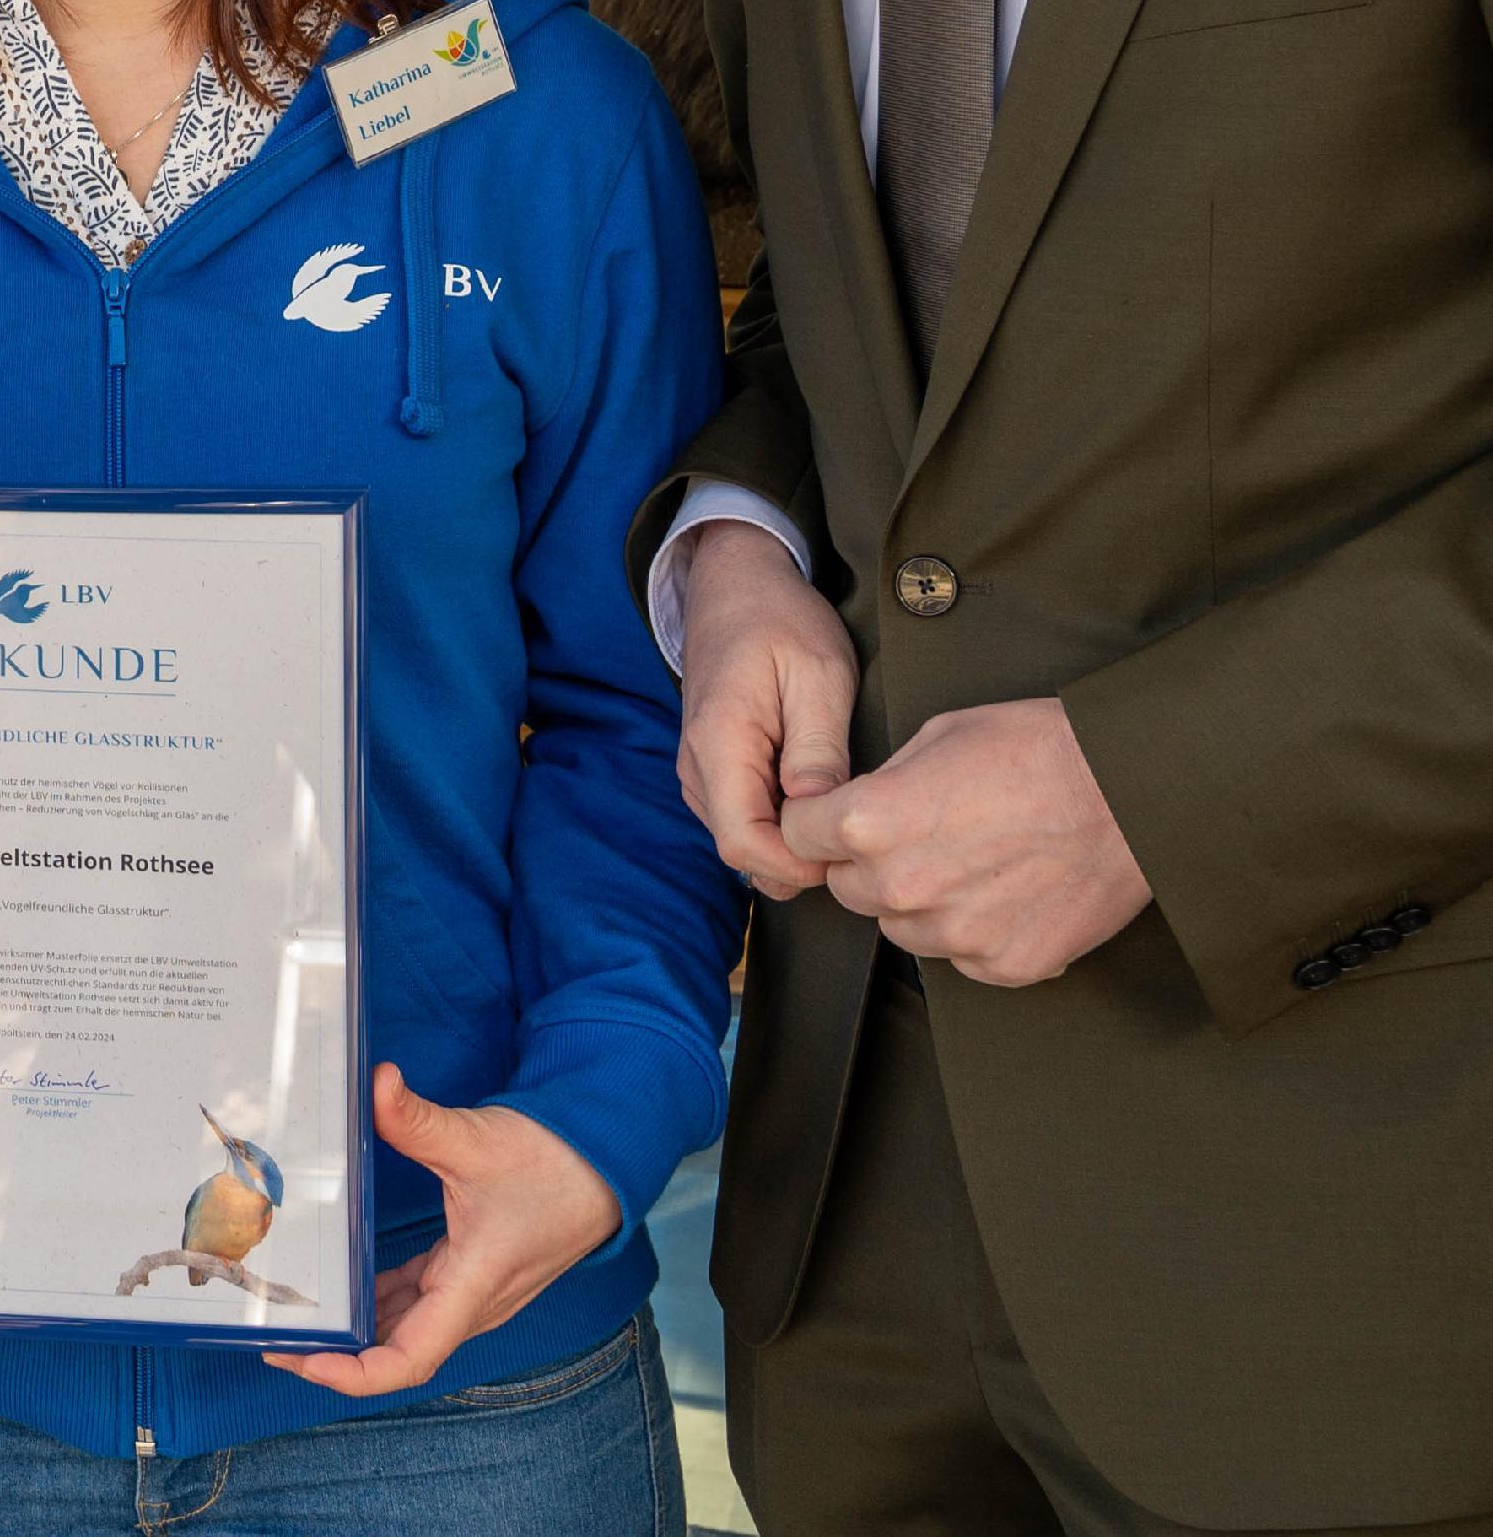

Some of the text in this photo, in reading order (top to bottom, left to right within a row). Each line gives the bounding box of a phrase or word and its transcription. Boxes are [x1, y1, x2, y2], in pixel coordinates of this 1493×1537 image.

[349, 62, 432, 109] Katharina
[358, 106, 412, 140] Liebel
[61, 584, 113, 604] LBV
[74, 731, 223, 751] GLASSTRUKTUR“
[120, 853, 215, 876] Rothsee
[11, 1094, 93, 1108] Peter Stimmler
